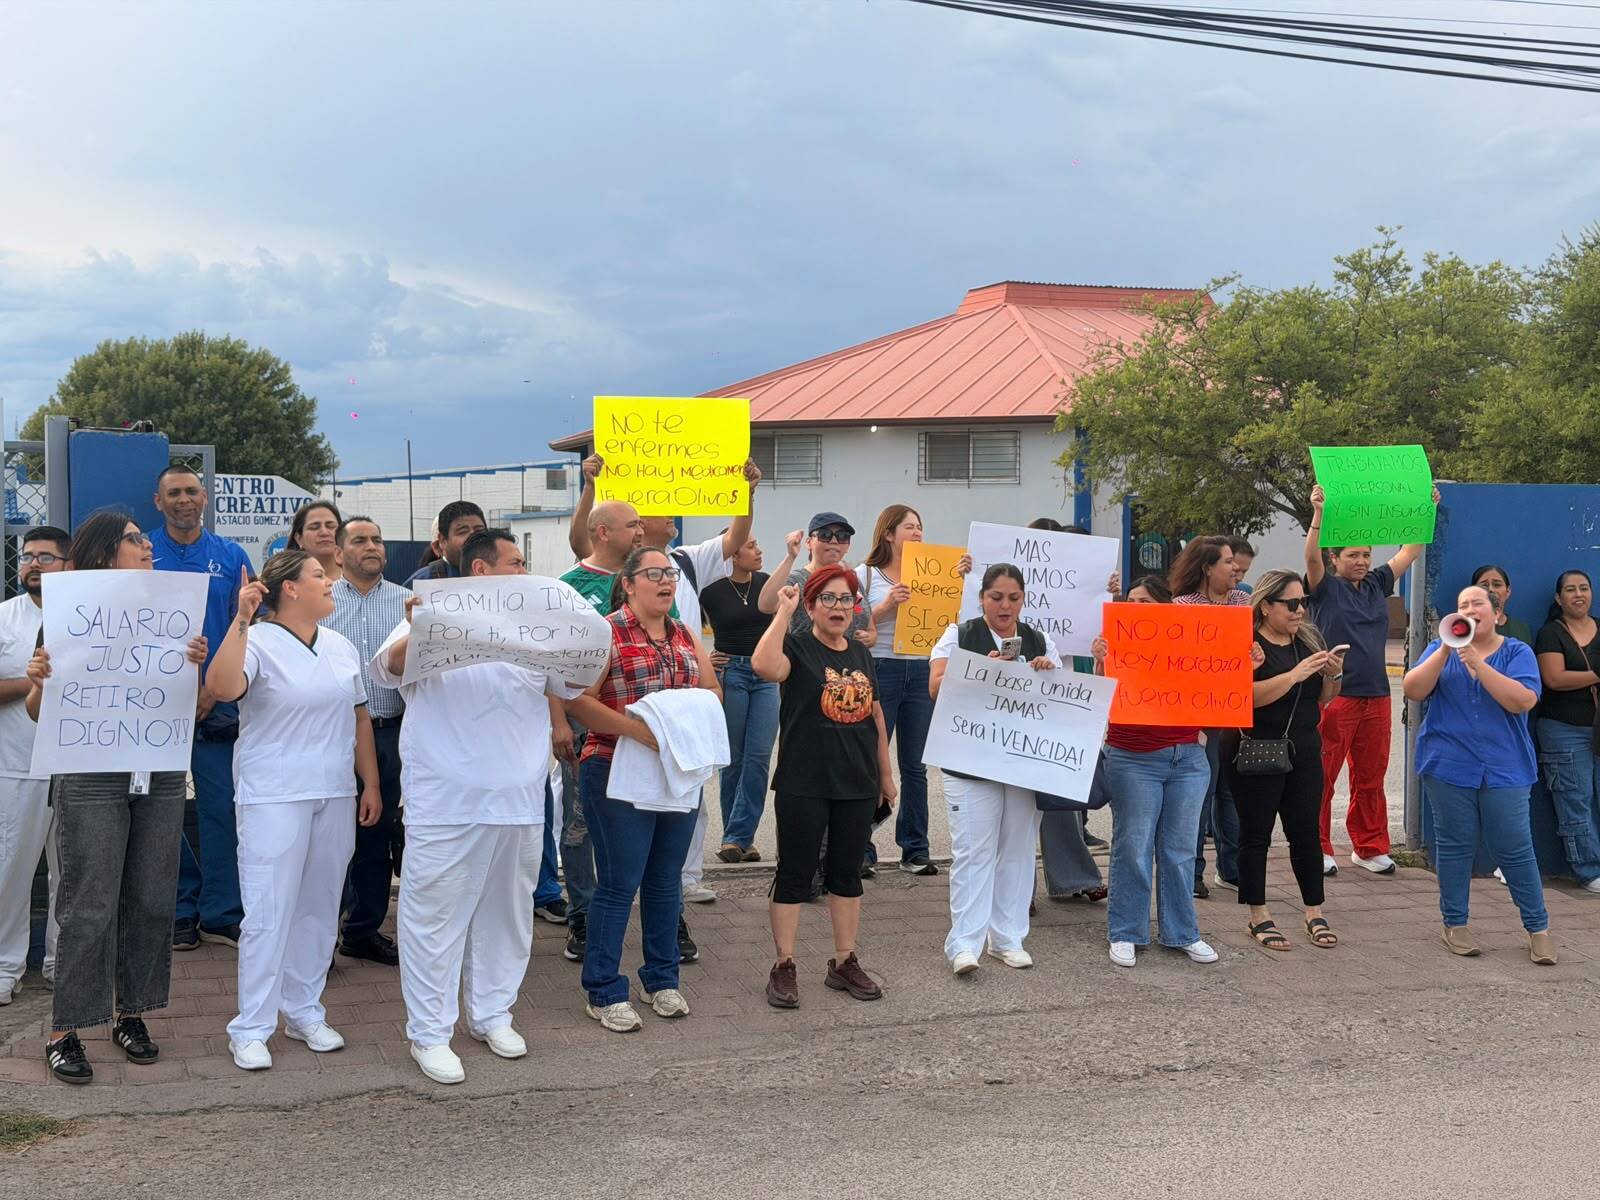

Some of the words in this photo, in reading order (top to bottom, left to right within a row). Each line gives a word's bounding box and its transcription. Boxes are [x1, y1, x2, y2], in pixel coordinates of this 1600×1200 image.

[612, 411, 644, 435] NO
[653, 410, 684, 434] te
[605, 438, 720, 460] enfermes
[605, 463, 632, 479] NO
[1318, 454, 1424, 474] TRABAJAMOS
[215, 477, 275, 495] ENTRO
[1354, 480, 1416, 497] PERSONAL
[215, 496, 313, 514] CREATIV
[1332, 503, 1342, 517] Y
[1349, 504, 1370, 518] SIN
[1378, 503, 1434, 519] INSUMOS
[216, 515, 251, 526] ASTACIO
[254, 515, 280, 526] GOMEZ
[1013, 538, 1051, 562] MAS
[915, 557, 942, 577] NO
[911, 579, 963, 599] Repre
[67, 604, 190, 640] SALARIO
[906, 605, 933, 630] SI
[1117, 620, 1159, 641] NO
[1166, 623, 1184, 640] a
[1197, 620, 1218, 643] la
[87, 644, 184, 677] JUSTO
[964, 659, 988, 682] La
[995, 670, 1033, 693] base
[1041, 681, 1092, 703] unida
[60, 681, 166, 712] RETIRO
[985, 693, 1047, 721] JAMAS
[950, 715, 985, 742] Sera
